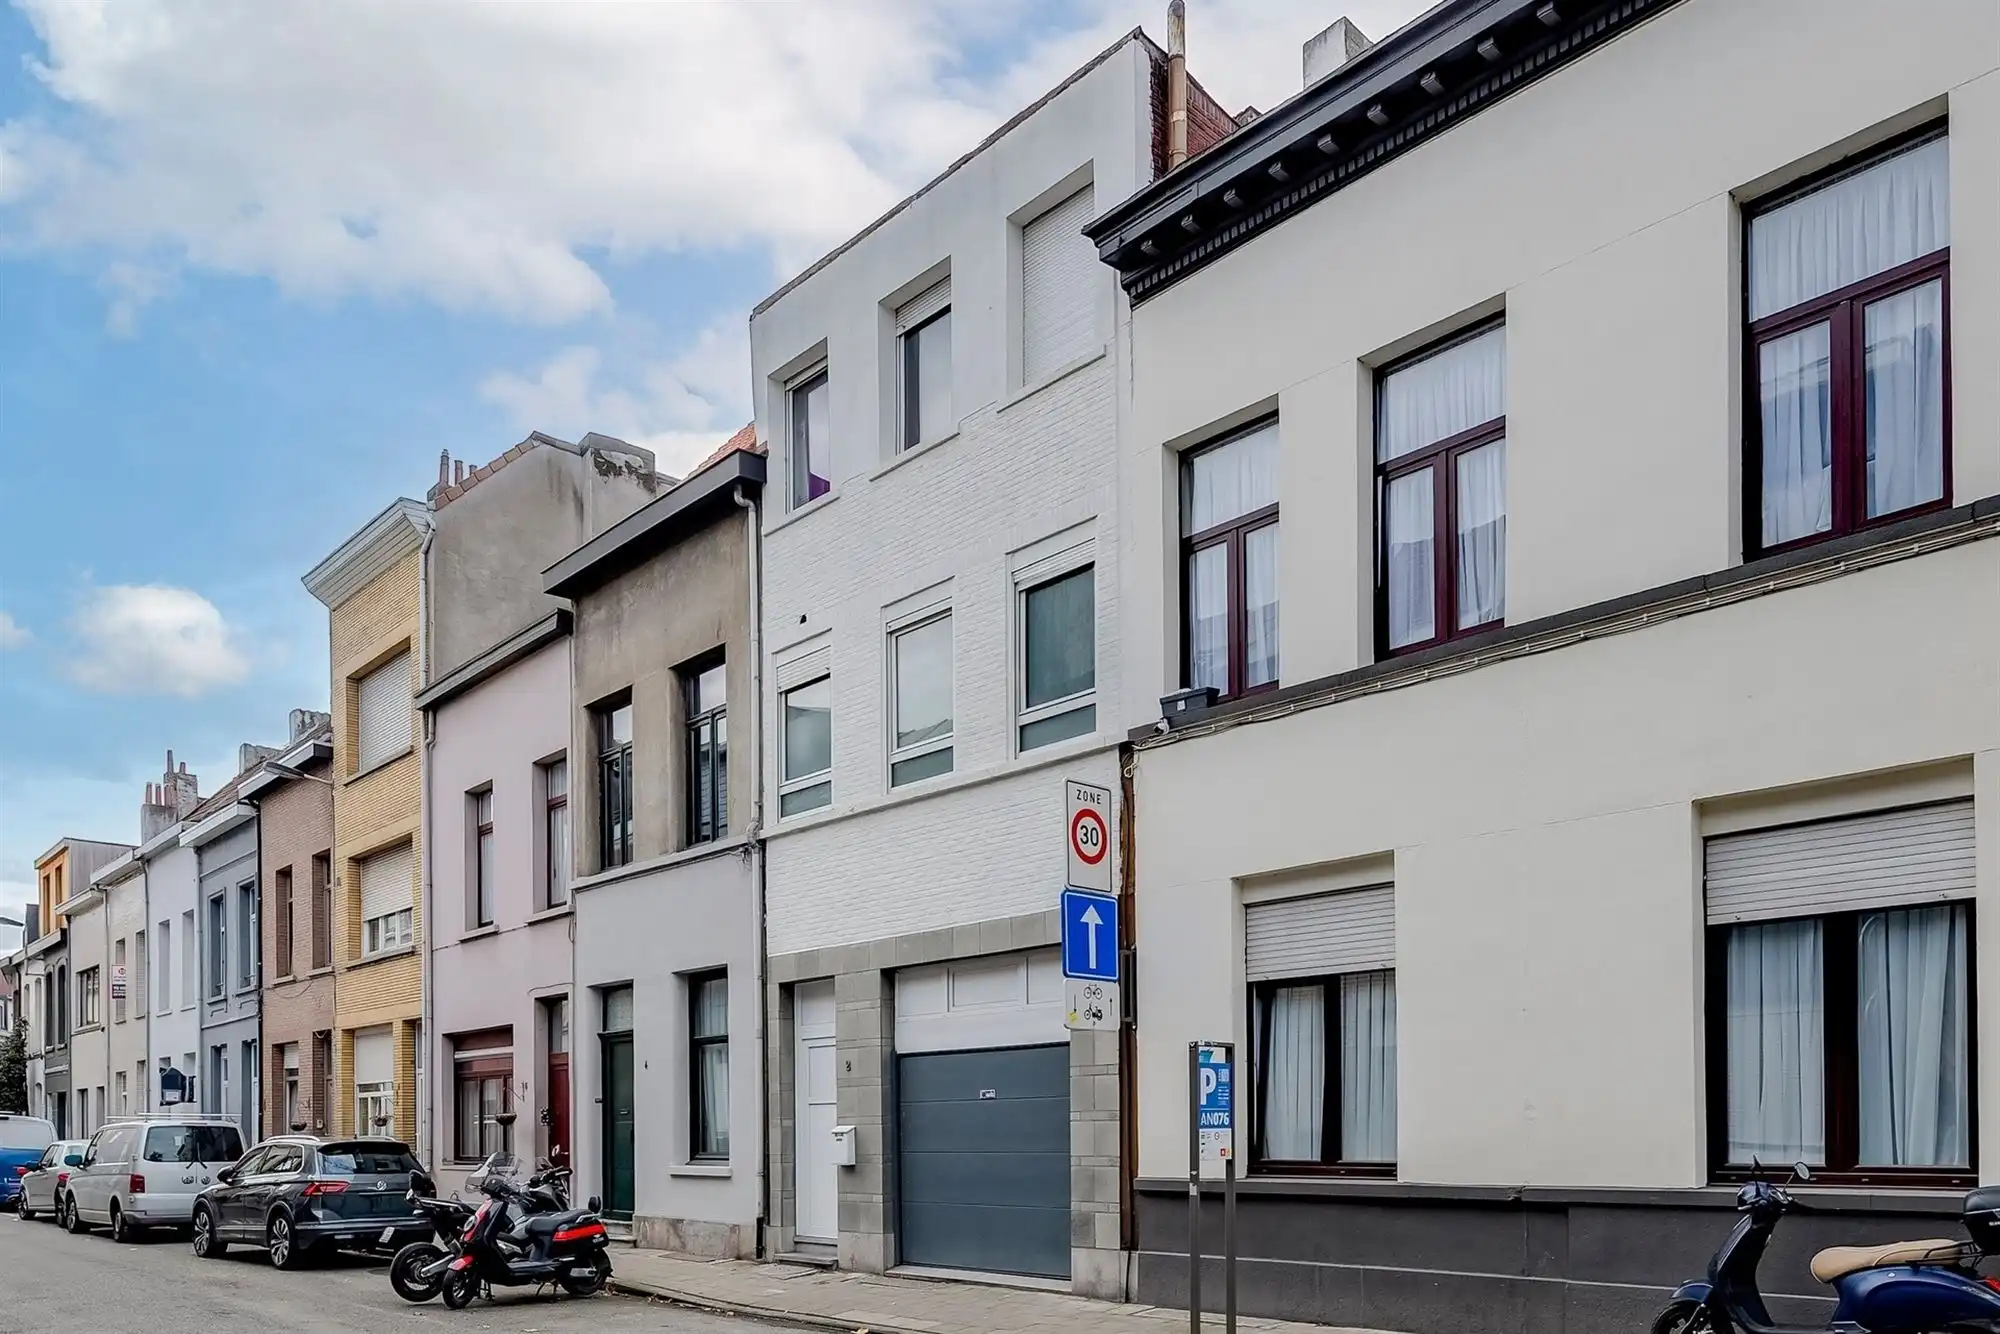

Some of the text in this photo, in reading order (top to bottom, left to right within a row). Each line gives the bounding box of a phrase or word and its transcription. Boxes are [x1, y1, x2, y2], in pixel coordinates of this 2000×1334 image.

[1077, 789, 1101, 804] ZONE
[1080, 825, 1098, 846] 30
[1200, 1067, 1216, 1105] P
[1201, 1112, 1229, 1125] AN076
